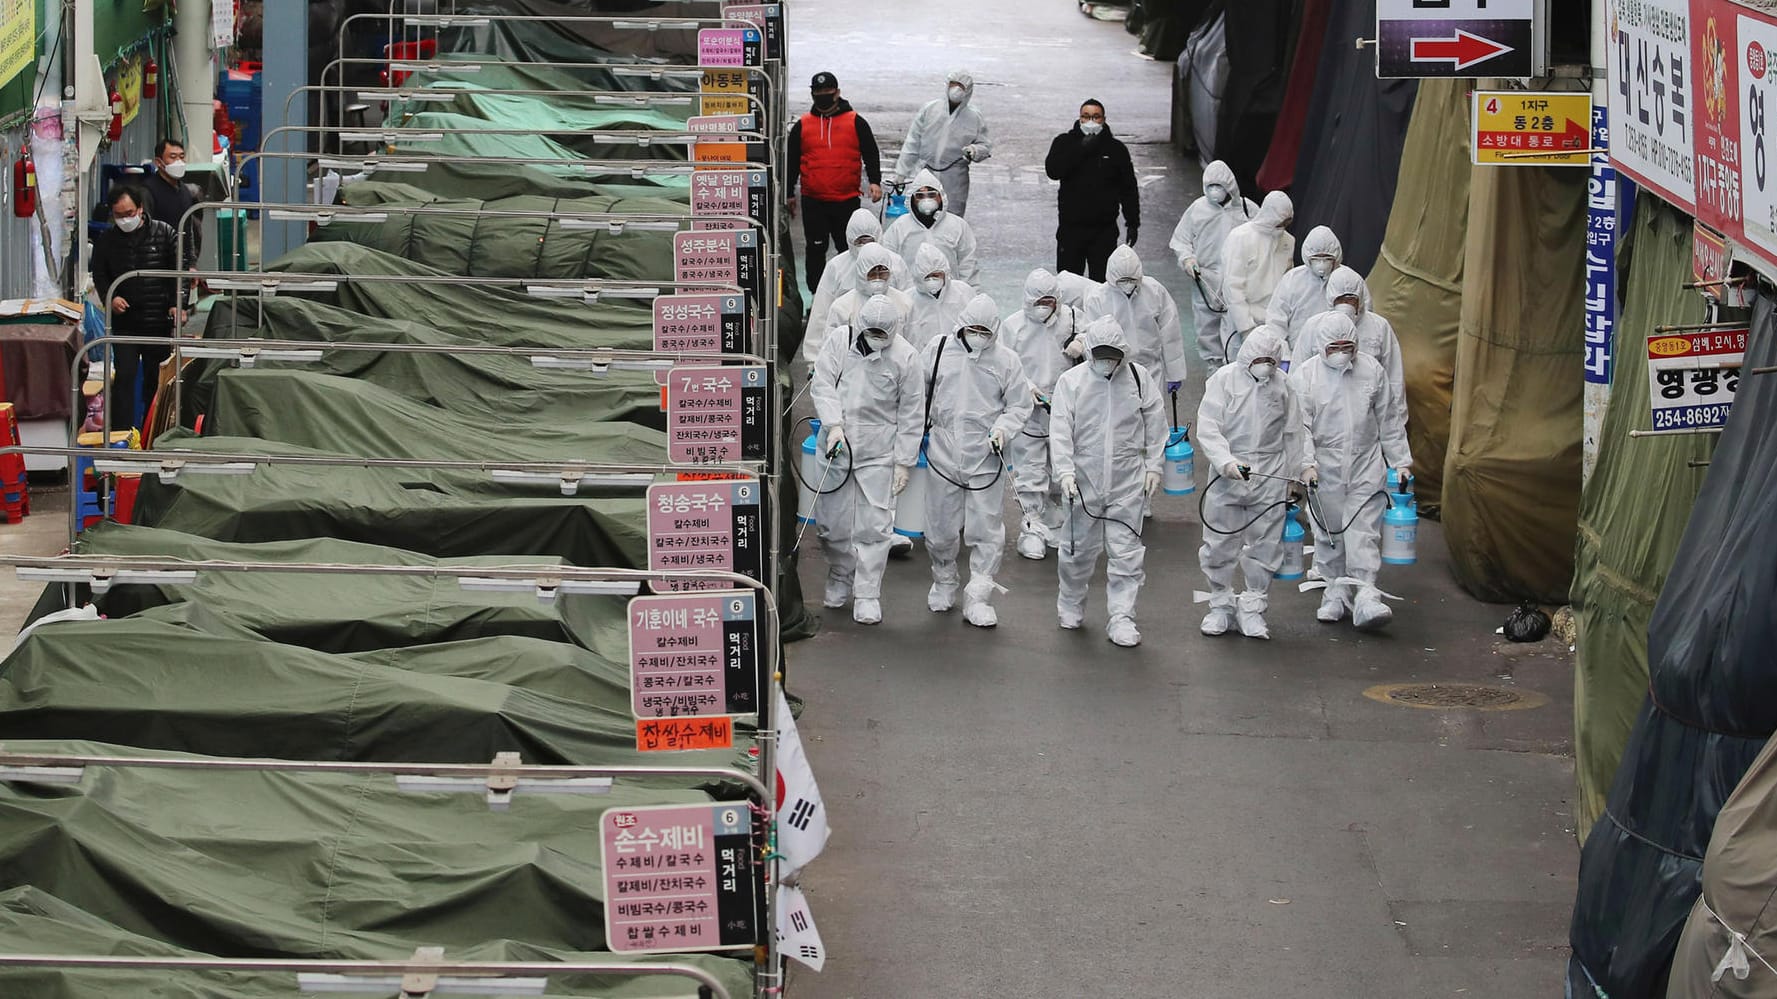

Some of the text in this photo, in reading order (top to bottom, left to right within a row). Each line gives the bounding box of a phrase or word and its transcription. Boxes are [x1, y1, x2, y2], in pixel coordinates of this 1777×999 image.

[703, 73, 743, 88] 아동복
[1619, 30, 1685, 144] 대신승복
[1486, 99, 1498, 114] 4
[1521, 100, 1549, 111] 1지구
[1514, 116, 1554, 131] 동 2층
[1482, 135, 1553, 148] 소방대 통로
[696, 174, 743, 187] 옛날 엄마
[1698, 154, 1716, 206] 1지구
[697, 187, 742, 200] 수제비
[697, 201, 742, 210] 칼국수/칼제비
[751, 193, 759, 217] 먹거리
[705, 222, 735, 230] 잔치국수
[681, 238, 730, 254] 성주분식
[682, 257, 730, 266] 칼국수/수제비
[740, 255, 749, 280] 먹거리
[682, 270, 731, 279] 콩국수/냉국수
[729, 299, 734, 307] 6
[661, 304, 716, 320] 정성국수
[662, 324, 715, 334] 칼국수/수제비
[725, 322, 733, 349] 먹거리
[662, 339, 715, 349] 콩국수/냉국수
[749, 372, 756, 380] 6
[681, 377, 732, 393] 7번 국수
[679, 399, 732, 409] 칼국수/수제비
[746, 396, 755, 426] 먹거리
[679, 415, 732, 424] 칼제비/콩국수
[1656, 406, 1720, 428] 254-8692
[676, 430, 738, 440] 잔치국수/냉국수
[686, 446, 728, 456] 비빔국수
[741, 487, 748, 497] 6
[658, 493, 725, 513] 청송국수
[674, 518, 710, 529] 칼수제비
[737, 515, 748, 549] 먹거리
[656, 536, 729, 548] 칼국수/잔치국수
[661, 554, 725, 565] 수제비/냉국수
[734, 602, 740, 612] 6
[636, 608, 719, 630] 기훈이네 국수
[656, 635, 698, 648] 칼수제비
[742, 632, 750, 651] Food
[729, 632, 741, 670] 먹거리
[638, 655, 718, 668] 수제비/잔치국수
[643, 675, 715, 688] 콩국수/칼국수
[642, 694, 717, 708] 냉국수/비빔국수
[642, 721, 727, 749] 찹쌀수제비
[615, 814, 637, 826] 원조
[725, 812, 734, 823] 6
[614, 824, 703, 852] 손수제비
[616, 853, 704, 869] 수제비/칼국수
[738, 849, 746, 870] Food
[721, 849, 736, 892] 먹거리
[617, 877, 706, 893] 칼제비/잔치국수
[618, 900, 708, 916] 비빔국수/콩국수
[627, 924, 702, 939] 찹쌀수제비
